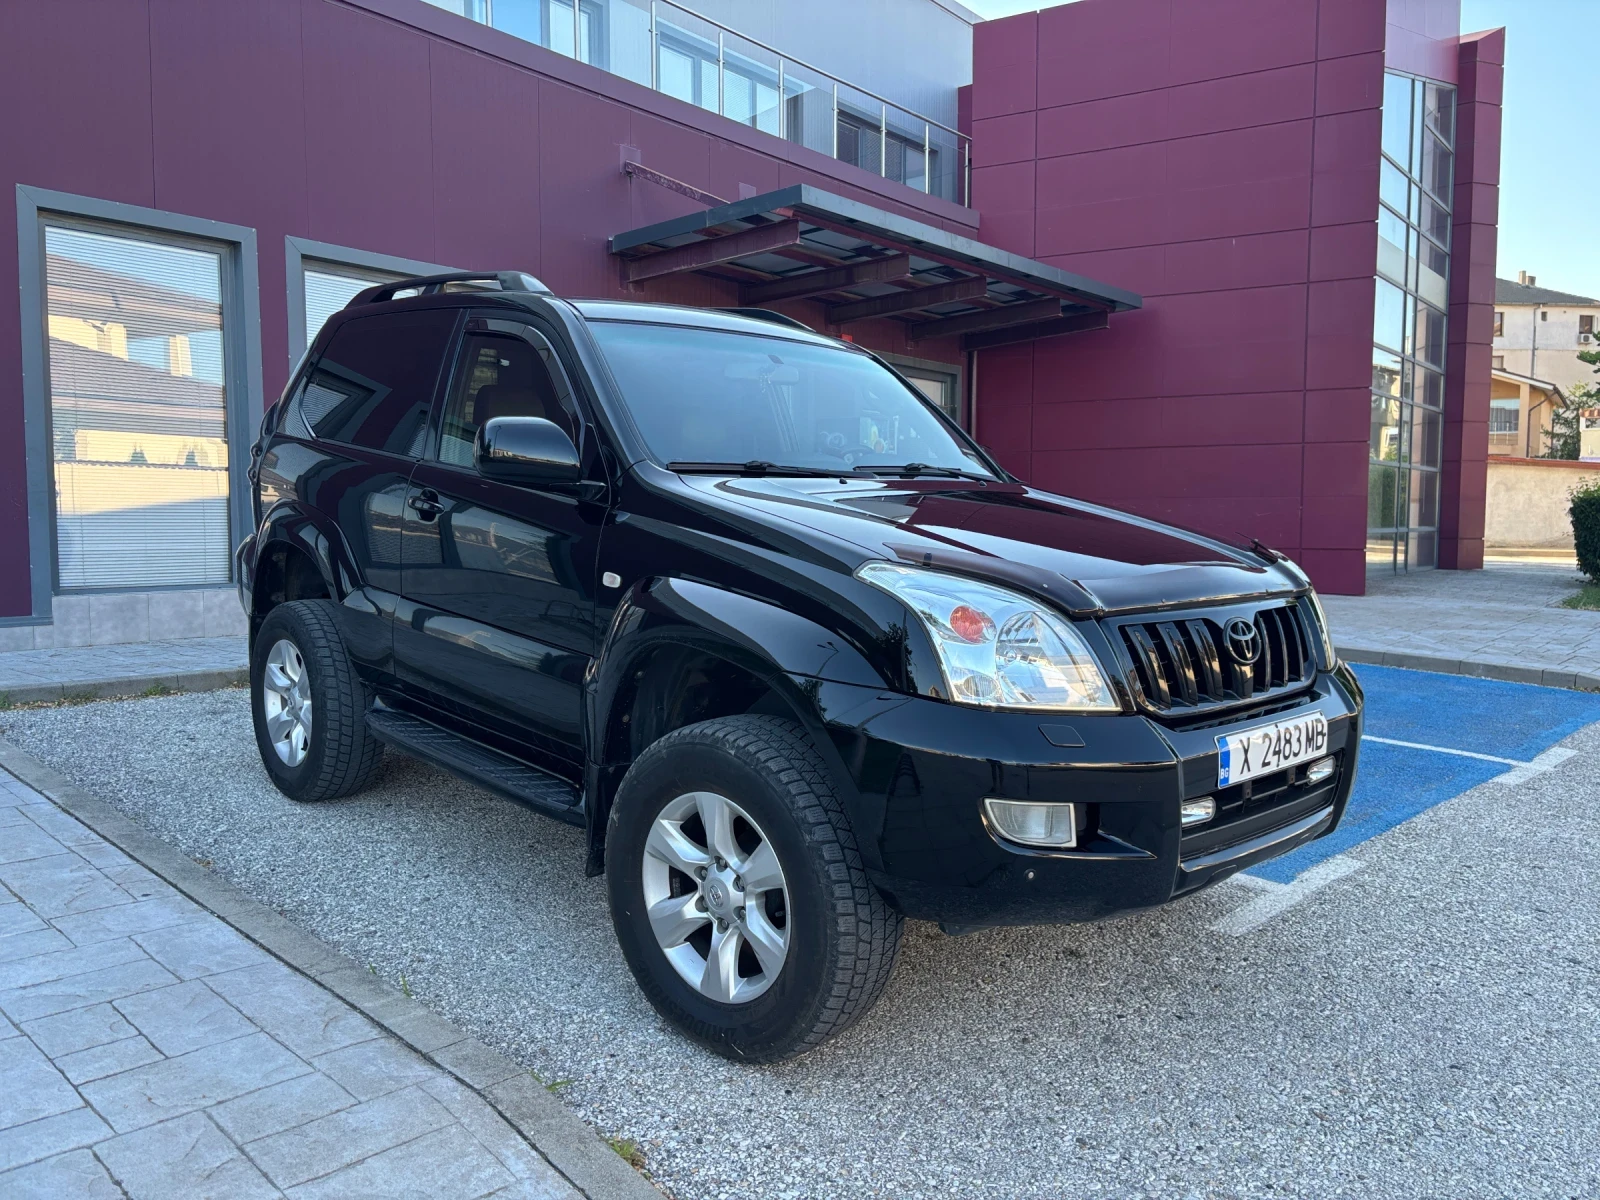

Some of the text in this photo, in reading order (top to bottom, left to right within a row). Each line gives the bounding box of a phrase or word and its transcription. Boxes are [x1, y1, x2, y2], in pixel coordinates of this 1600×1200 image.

[1239, 717, 1326, 775] X 2483 MB
[1220, 767, 1229, 780] BG
